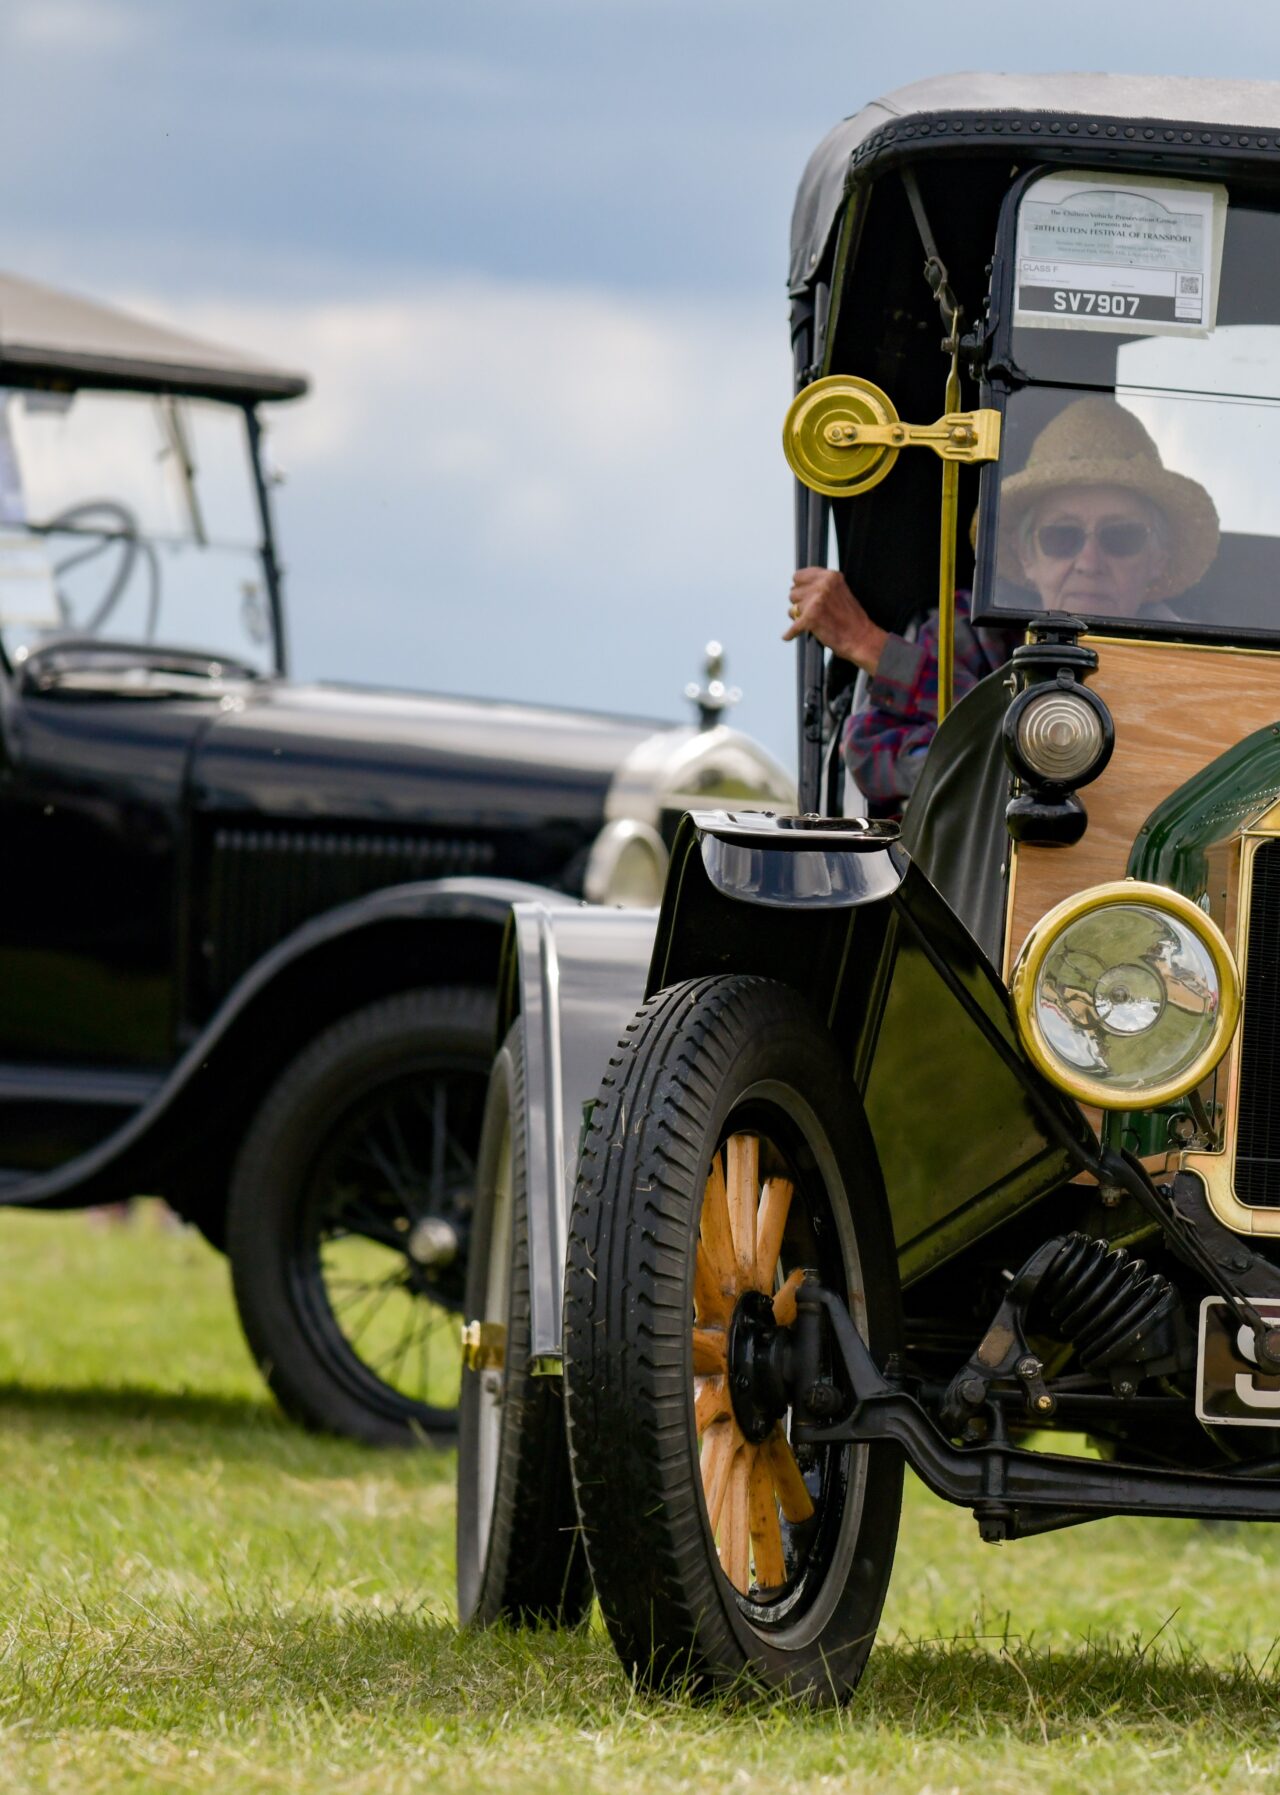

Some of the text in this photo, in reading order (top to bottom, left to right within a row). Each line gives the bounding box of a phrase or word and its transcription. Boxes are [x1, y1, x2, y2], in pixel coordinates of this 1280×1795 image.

[1057, 225, 1088, 234] LUTON
[1090, 228, 1125, 237] FESTIVAL
[1128, 231, 1140, 239] OF
[1143, 232, 1192, 243] TRANSPORT
[1023, 263, 1051, 272] CLASS
[1053, 291, 1140, 316] SV7907
